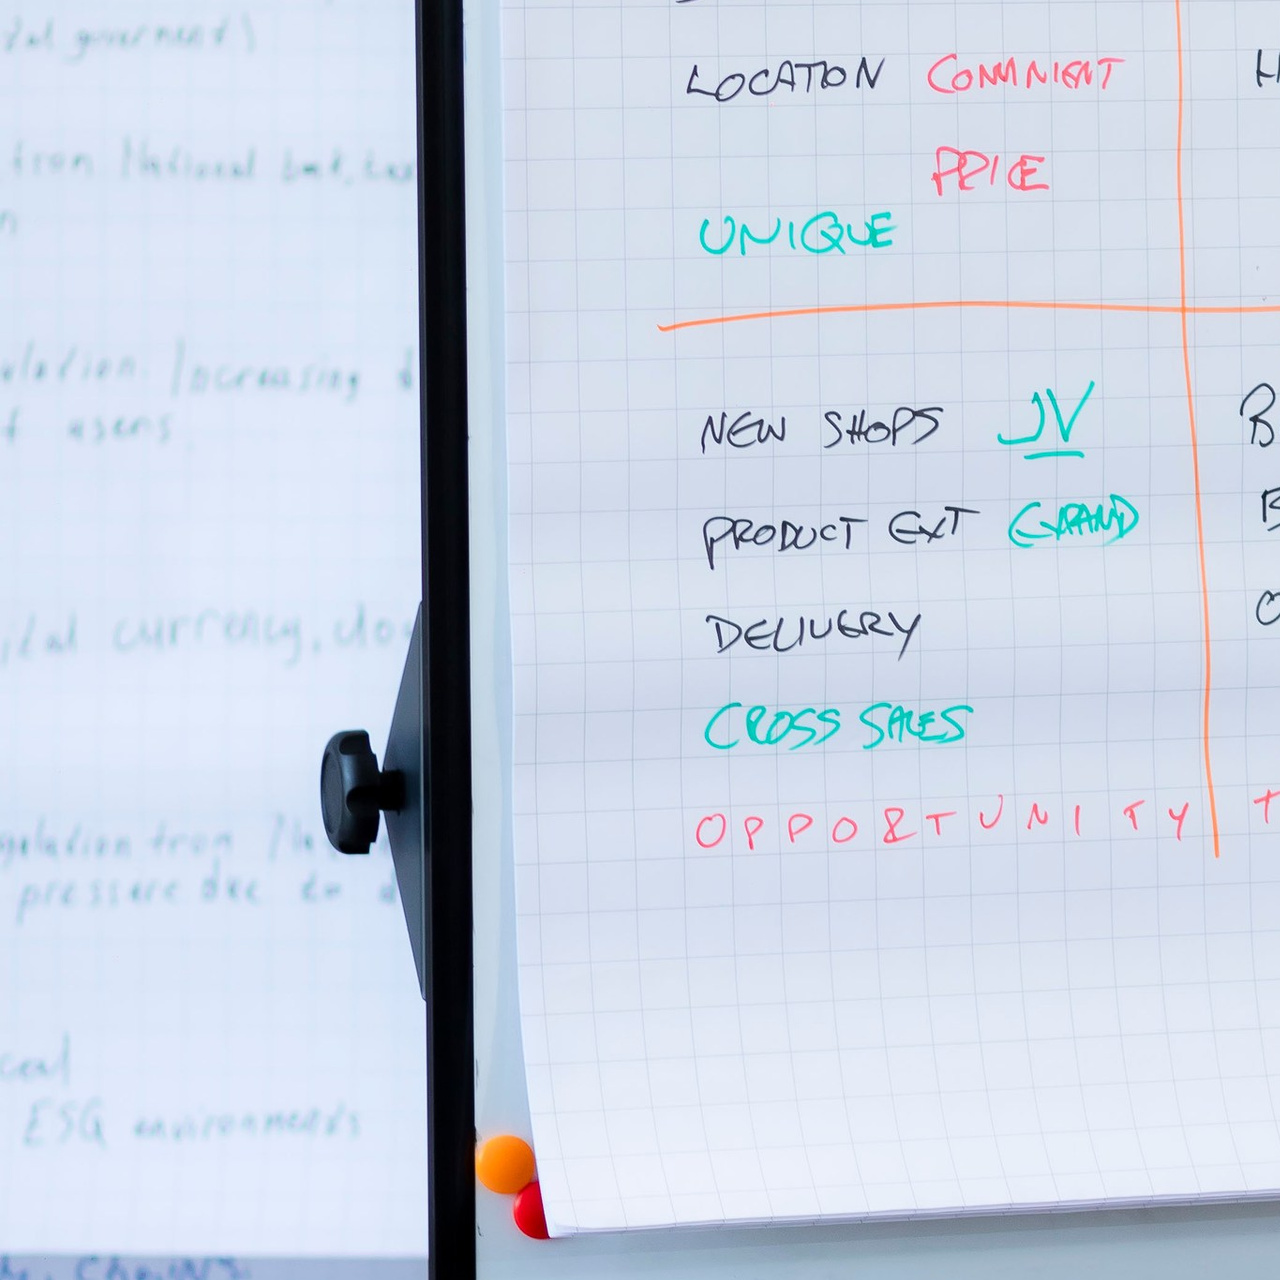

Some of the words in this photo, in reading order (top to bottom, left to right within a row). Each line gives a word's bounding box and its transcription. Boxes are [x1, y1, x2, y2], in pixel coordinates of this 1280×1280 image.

[686, 56, 885, 103] LOCATION
[930, 145, 1050, 196] PRICE
[698, 210, 896, 257] UNIQUE
[700, 410, 786, 455] NEW
[823, 406, 944, 449] SHOPS
[996, 380, 1096, 446] JV
[702, 516, 869, 571] PRODUCT
[888, 505, 981, 545] EXT
[705, 609, 922, 661] DELIVERY
[703, 701, 841, 751] CROSS
[858, 701, 975, 750] SALES
[695, 793, 1189, 851] OPPORTUNITY
